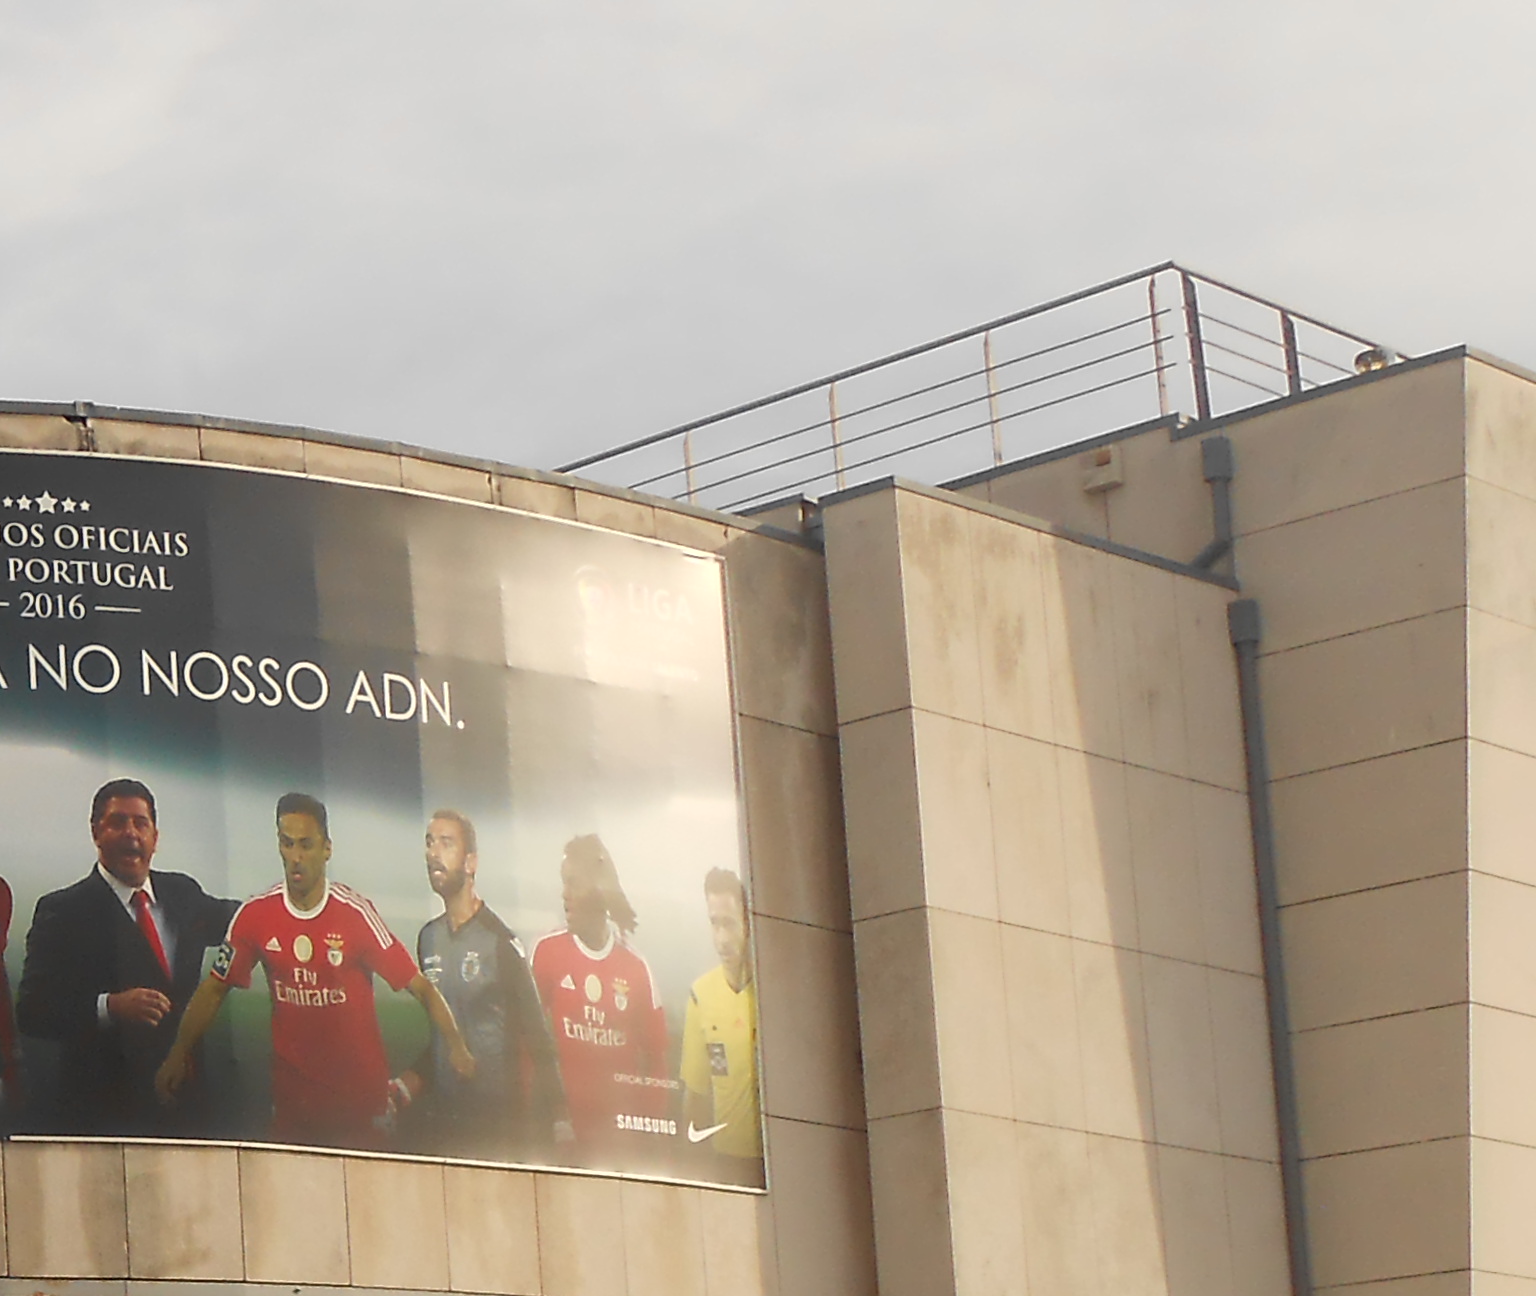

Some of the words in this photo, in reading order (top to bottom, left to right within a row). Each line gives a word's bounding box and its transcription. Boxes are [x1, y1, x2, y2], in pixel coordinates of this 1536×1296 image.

[53, 525, 190, 557] OFICIAIS
[7, 558, 175, 591] PORTUGAL
[19, 591, 88, 620] 2016
[28, 642, 122, 693] NO
[141, 649, 330, 711] NOSSO
[344, 670, 466, 730] ADN.
[293, 966, 317, 987] Fly
[274, 979, 348, 1008] Emirates
[583, 1004, 608, 1027] Fly
[562, 1016, 628, 1047] Emirates
[616, 1114, 678, 1136] SAMSUNG
